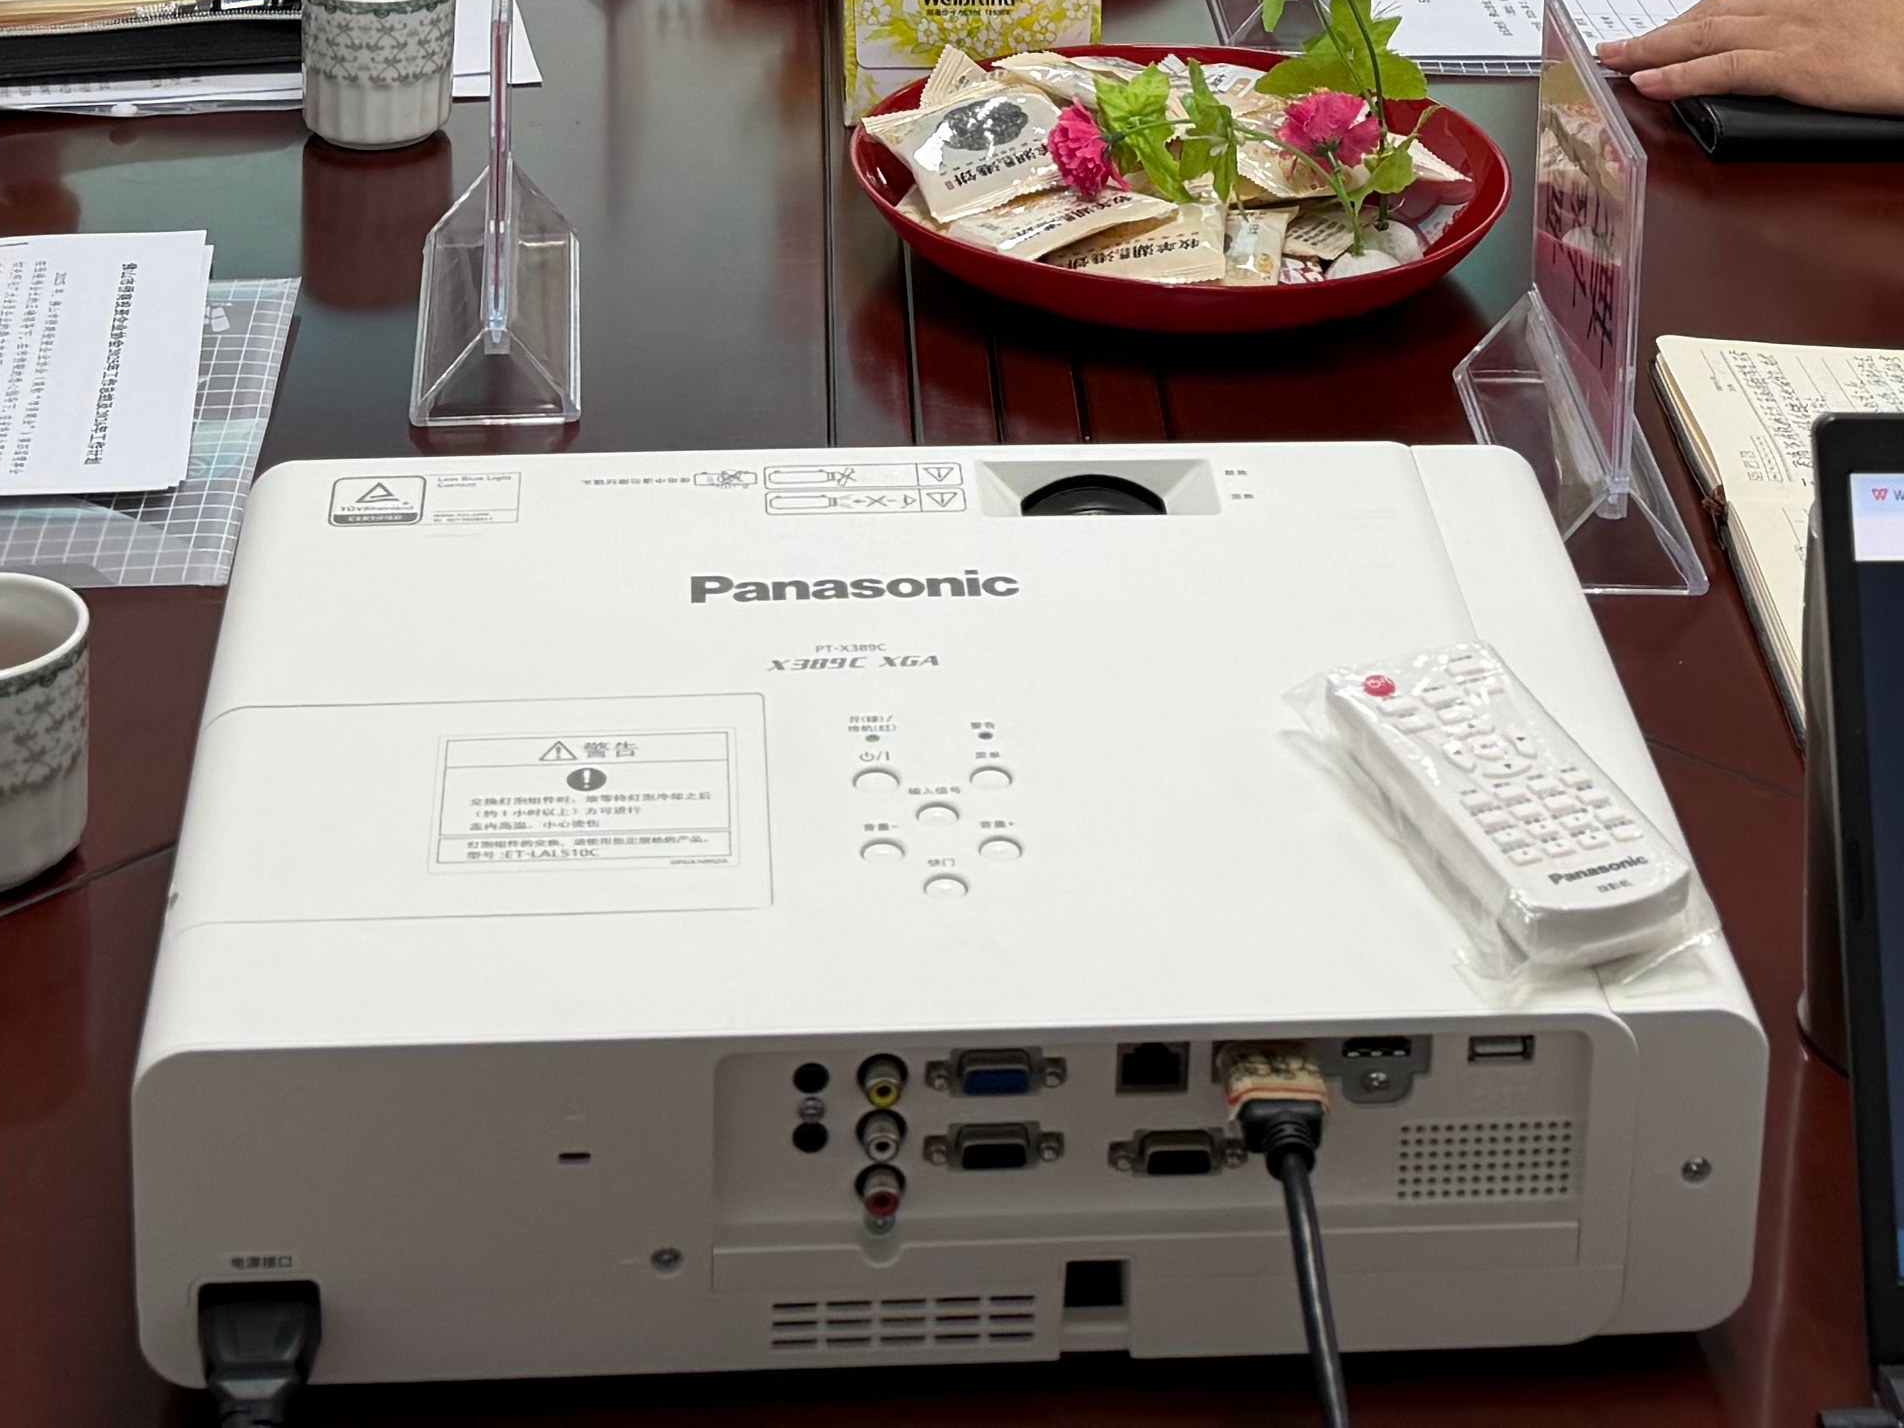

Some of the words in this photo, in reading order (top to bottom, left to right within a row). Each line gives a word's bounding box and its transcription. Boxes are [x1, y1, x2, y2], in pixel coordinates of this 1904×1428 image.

[689, 568, 1020, 607] Panasonic
[815, 643, 887, 654] PT-X389C
[767, 655, 869, 672] X389C
[878, 654, 940, 669] XGA
[583, 741, 639, 758] 警告
[1548, 854, 1649, 885] Panasonic
